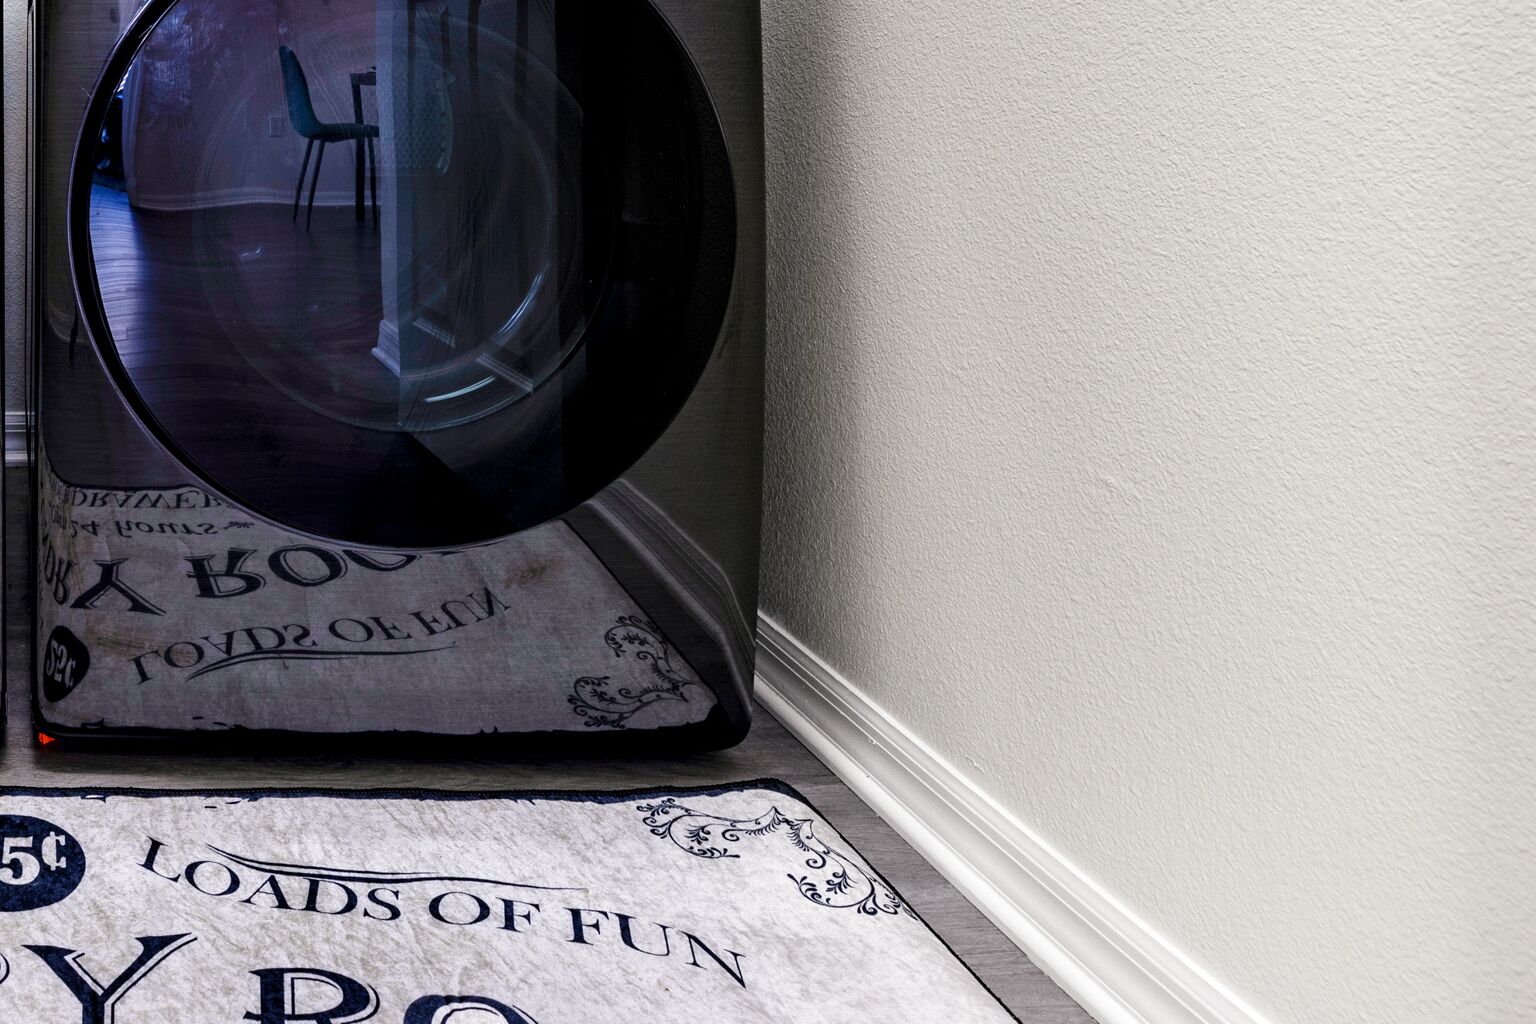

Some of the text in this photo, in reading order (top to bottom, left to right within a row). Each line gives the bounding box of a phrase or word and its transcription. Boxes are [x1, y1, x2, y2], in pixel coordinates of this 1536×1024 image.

[135, 837, 746, 989] LOADS OF FUN
